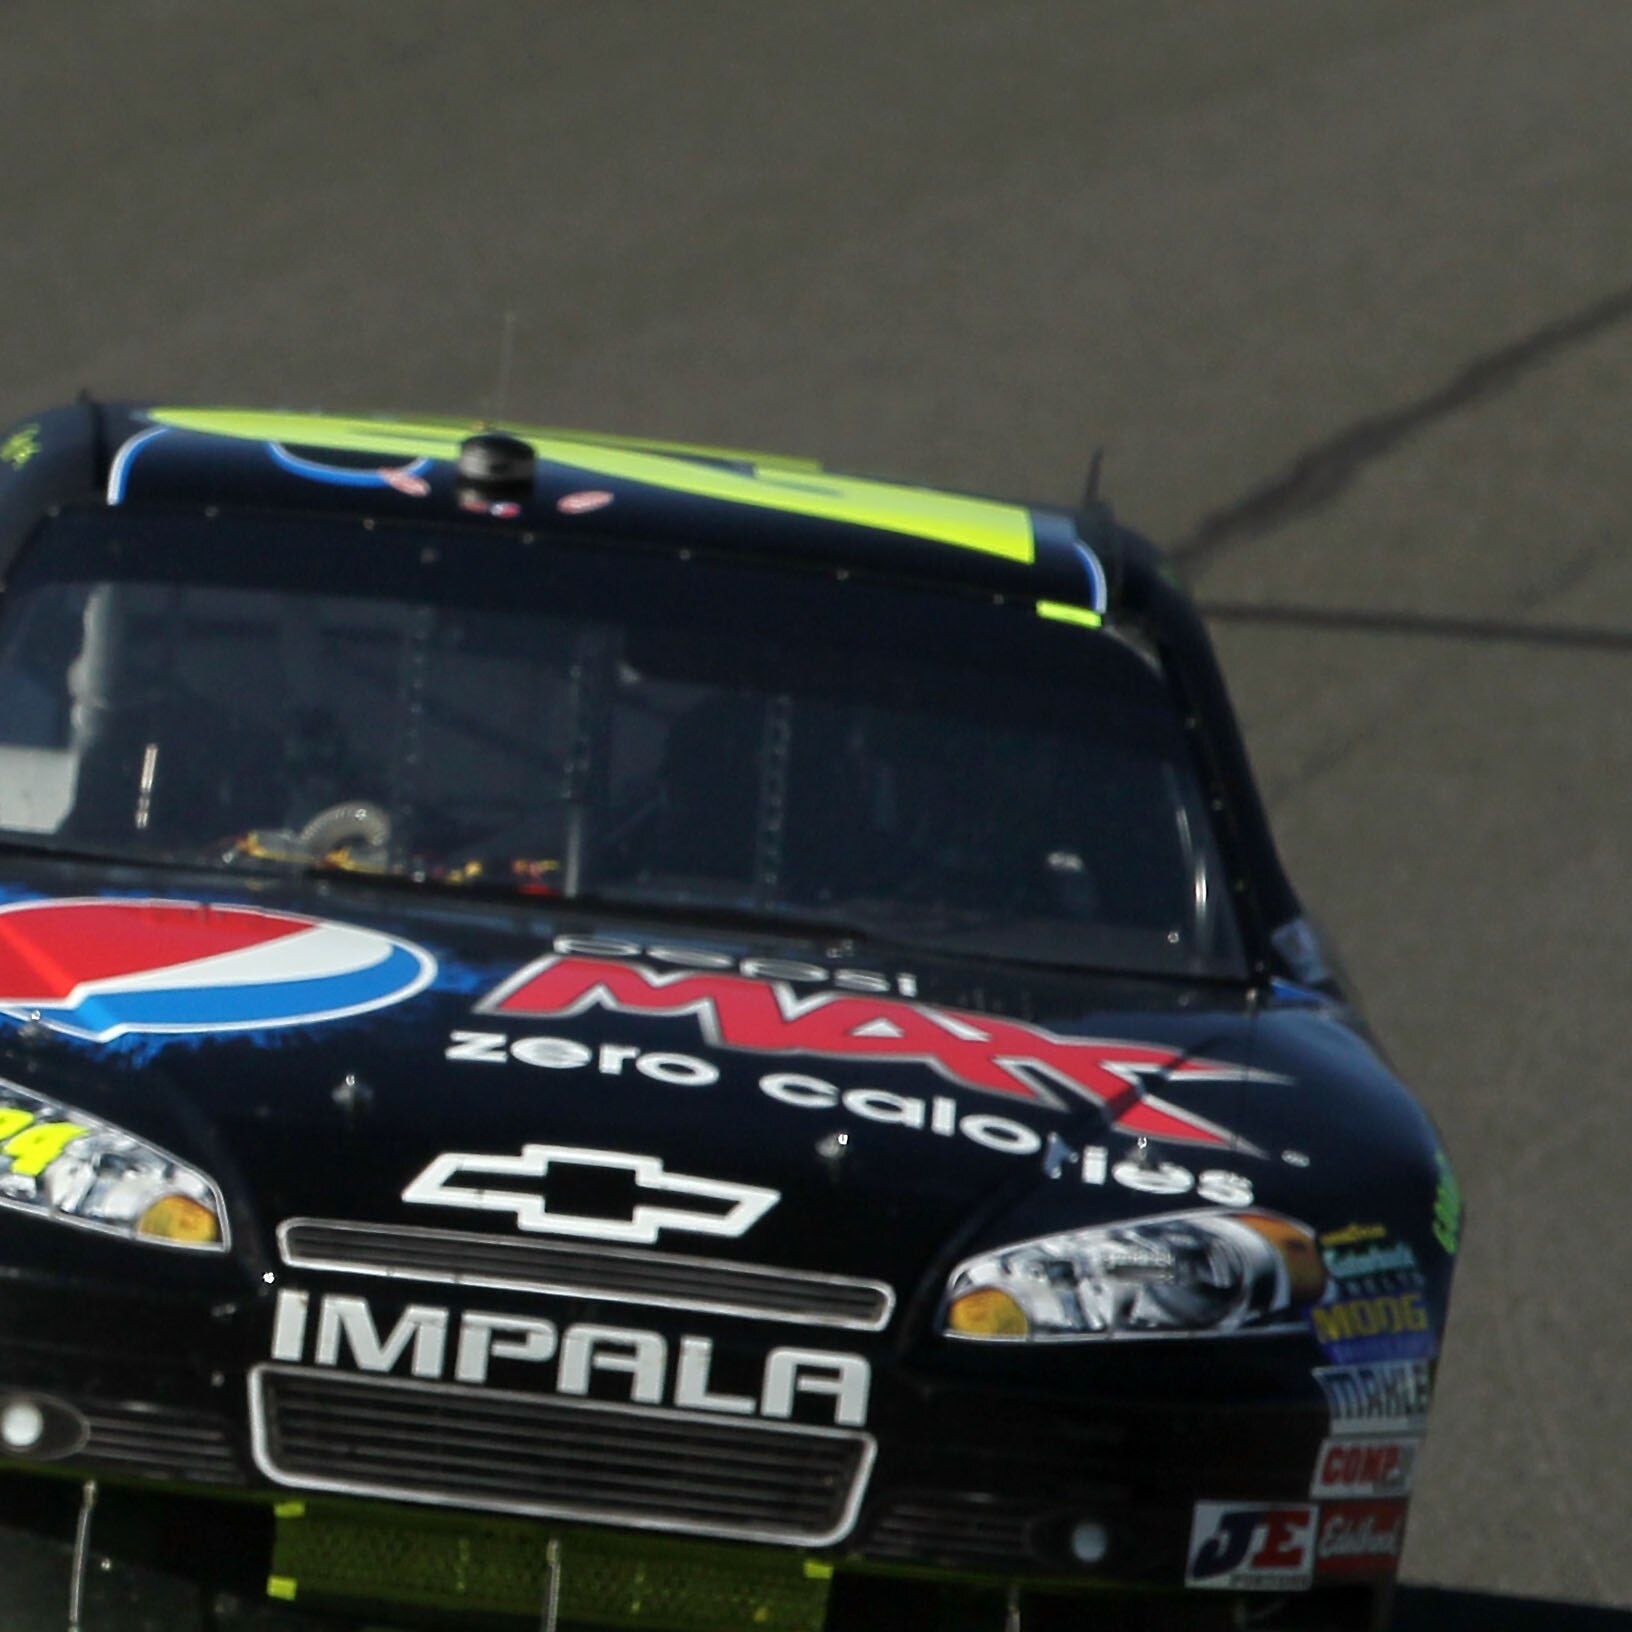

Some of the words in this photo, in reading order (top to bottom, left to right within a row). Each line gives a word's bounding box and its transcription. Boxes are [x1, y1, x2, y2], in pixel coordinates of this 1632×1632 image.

[446, 1029, 720, 1086] zero
[472, 953, 1296, 1159] MAX
[1312, 1294, 1429, 1344] MOOG
[271, 1289, 871, 1428] IMPALA
[1322, 1446, 1400, 1486] COMP
